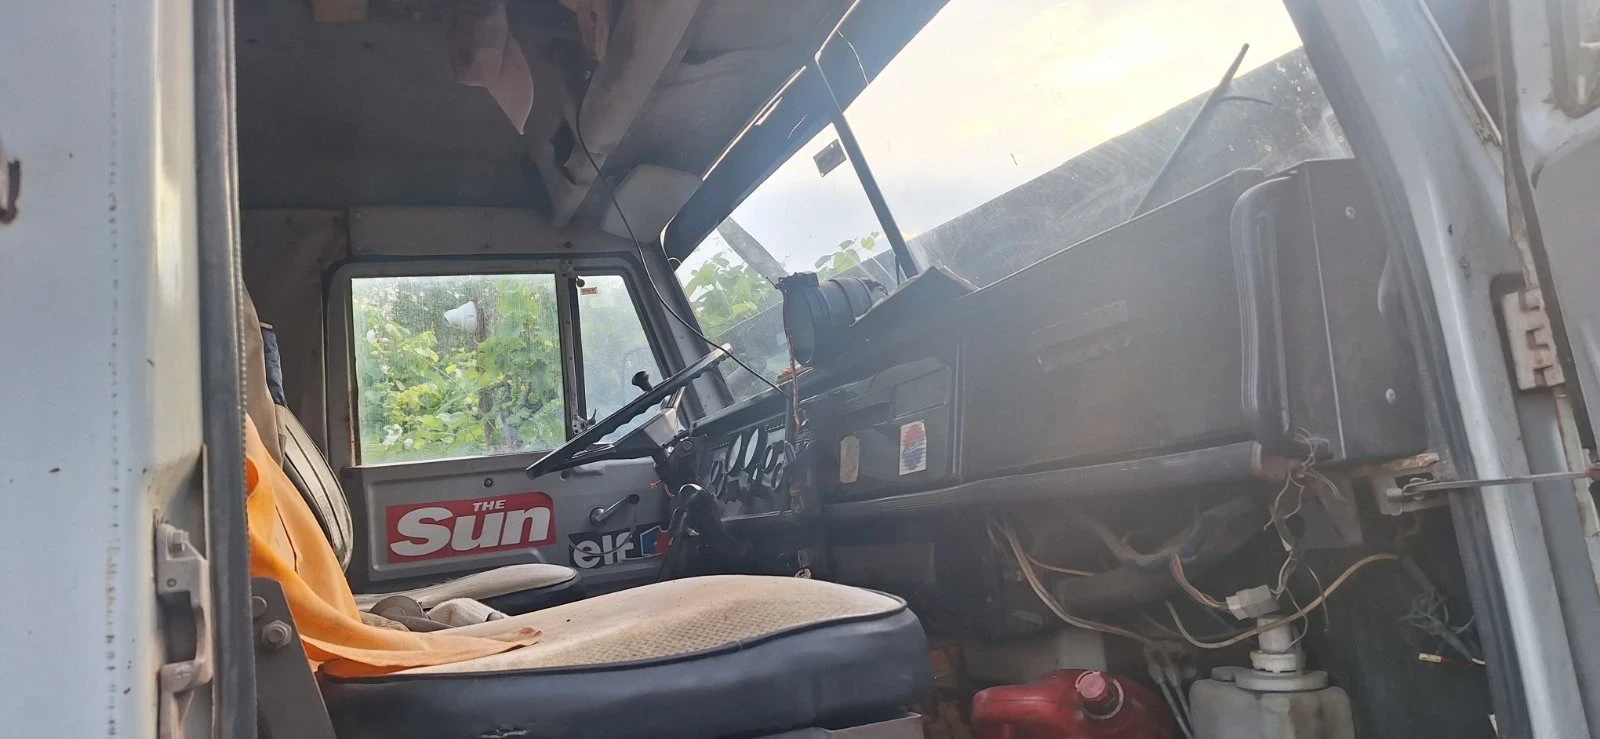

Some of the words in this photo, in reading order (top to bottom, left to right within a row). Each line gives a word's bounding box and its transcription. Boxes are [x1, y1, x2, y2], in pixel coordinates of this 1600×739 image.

[473, 499, 507, 512] THE
[389, 506, 551, 556] Sun
[573, 531, 634, 569] elf
